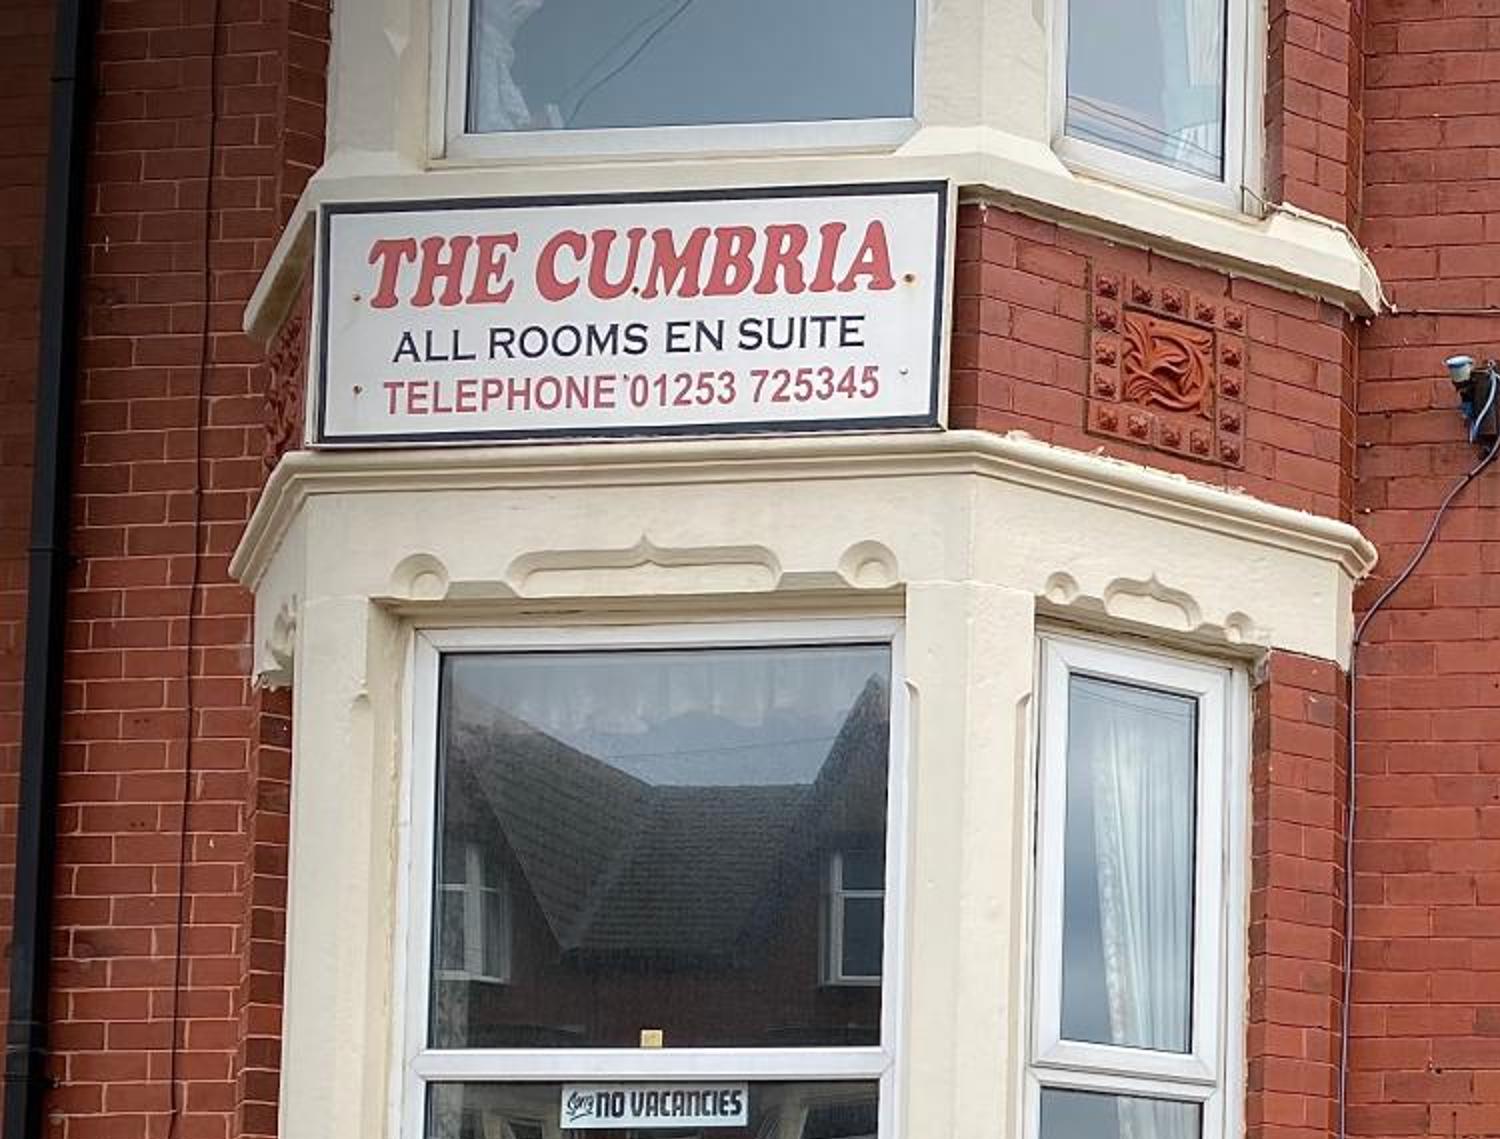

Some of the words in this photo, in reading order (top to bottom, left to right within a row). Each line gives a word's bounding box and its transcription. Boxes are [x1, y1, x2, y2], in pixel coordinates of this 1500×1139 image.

[368, 232, 518, 309] THE
[535, 219, 897, 301] CUMBRIA
[392, 329, 476, 364] ALL
[488, 321, 649, 360] ROOMS
[665, 319, 726, 353] EN
[737, 314, 866, 351] SUITE
[384, 374, 617, 416] TELEPHONE
[629, 371, 736, 409] 01253
[751, 364, 880, 403] 725345
[596, 1090, 625, 1118] NO
[631, 1089, 743, 1117] VACANCIES
